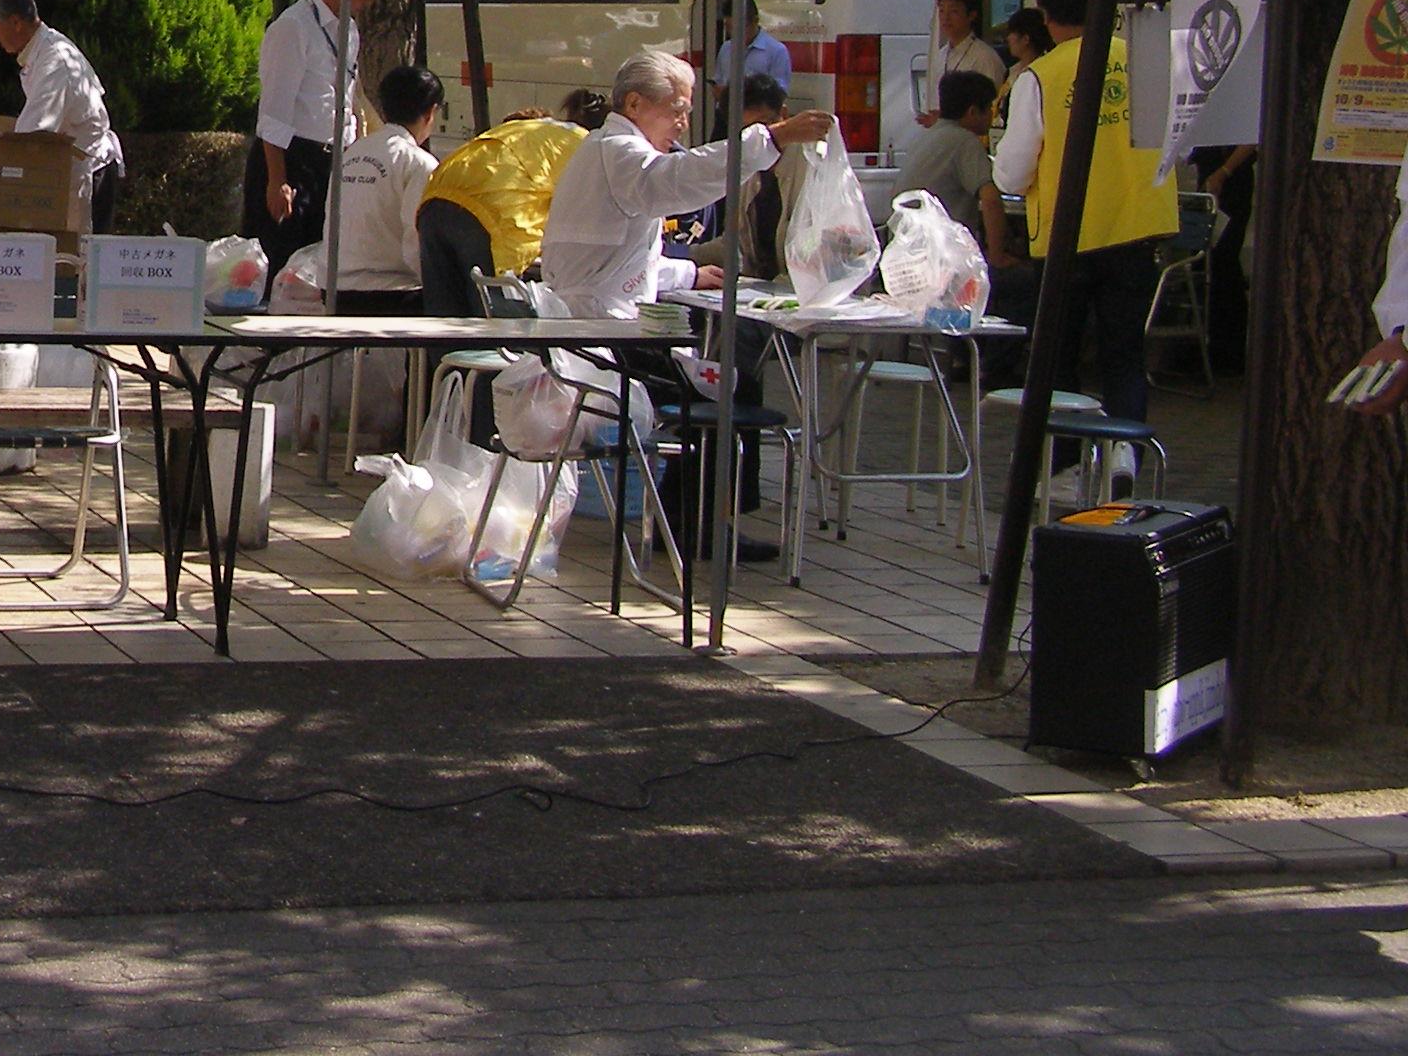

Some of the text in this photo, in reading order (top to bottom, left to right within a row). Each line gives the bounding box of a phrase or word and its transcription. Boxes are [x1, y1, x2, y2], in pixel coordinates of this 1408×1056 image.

[119, 248, 176, 261] 中古メガネ
[147, 267, 173, 278] BOX
[622, 270, 647, 294] Give
